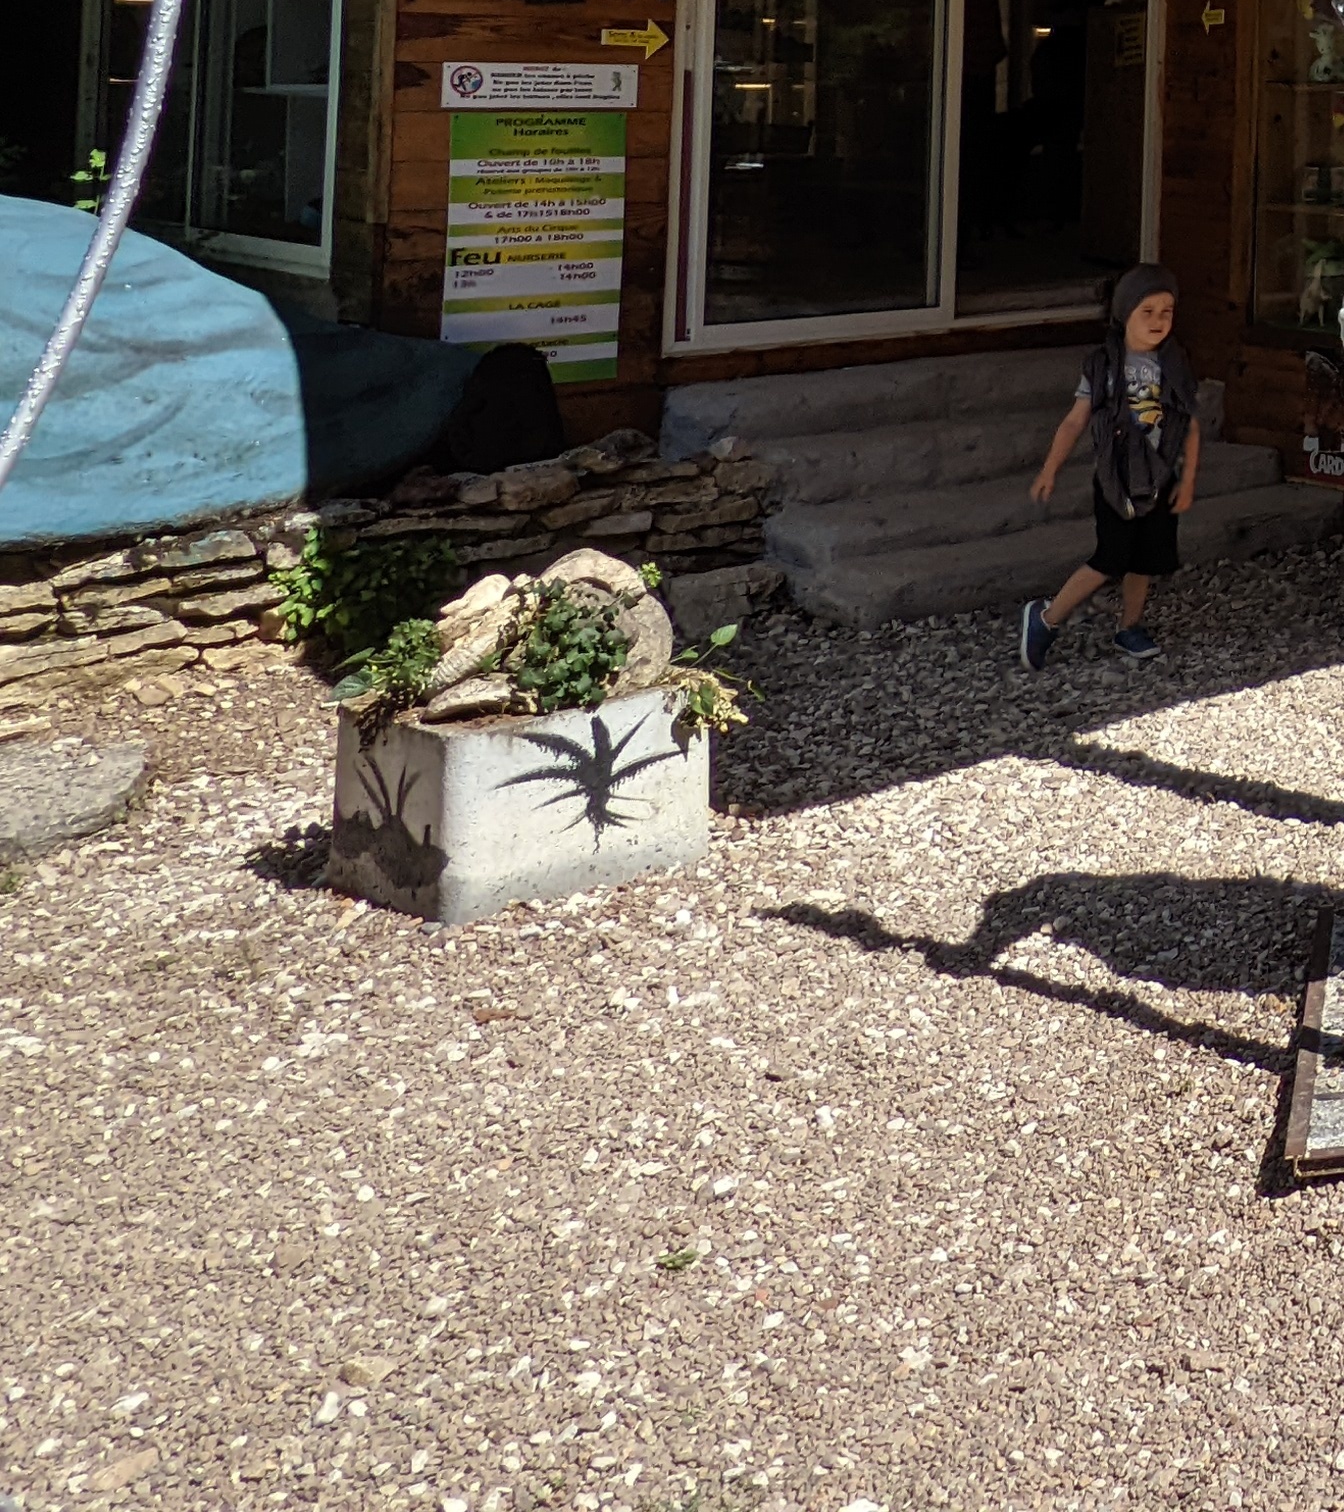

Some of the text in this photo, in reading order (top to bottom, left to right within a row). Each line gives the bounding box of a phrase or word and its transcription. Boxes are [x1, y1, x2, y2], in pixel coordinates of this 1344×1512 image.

[495, 116, 588, 128] PROGRAMME
[512, 127, 570, 137] Horaires
[489, 146, 592, 158] Champ de fouilles
[477, 159, 521, 168] Ouvert
[523, 159, 539, 167] de
[579, 157, 601, 166] 18h
[475, 176, 526, 186] Ateliers
[468, 200, 512, 210] Ouvert
[513, 200, 529, 209] de
[533, 199, 556, 209] 14h
[496, 210, 513, 219] de
[525, 225, 540, 233] du
[494, 235, 533, 244] 17h00
[547, 233, 585, 241] 18h00
[450, 247, 567, 268] Feu NURSERIE
[509, 300, 562, 311] LA CAGE
